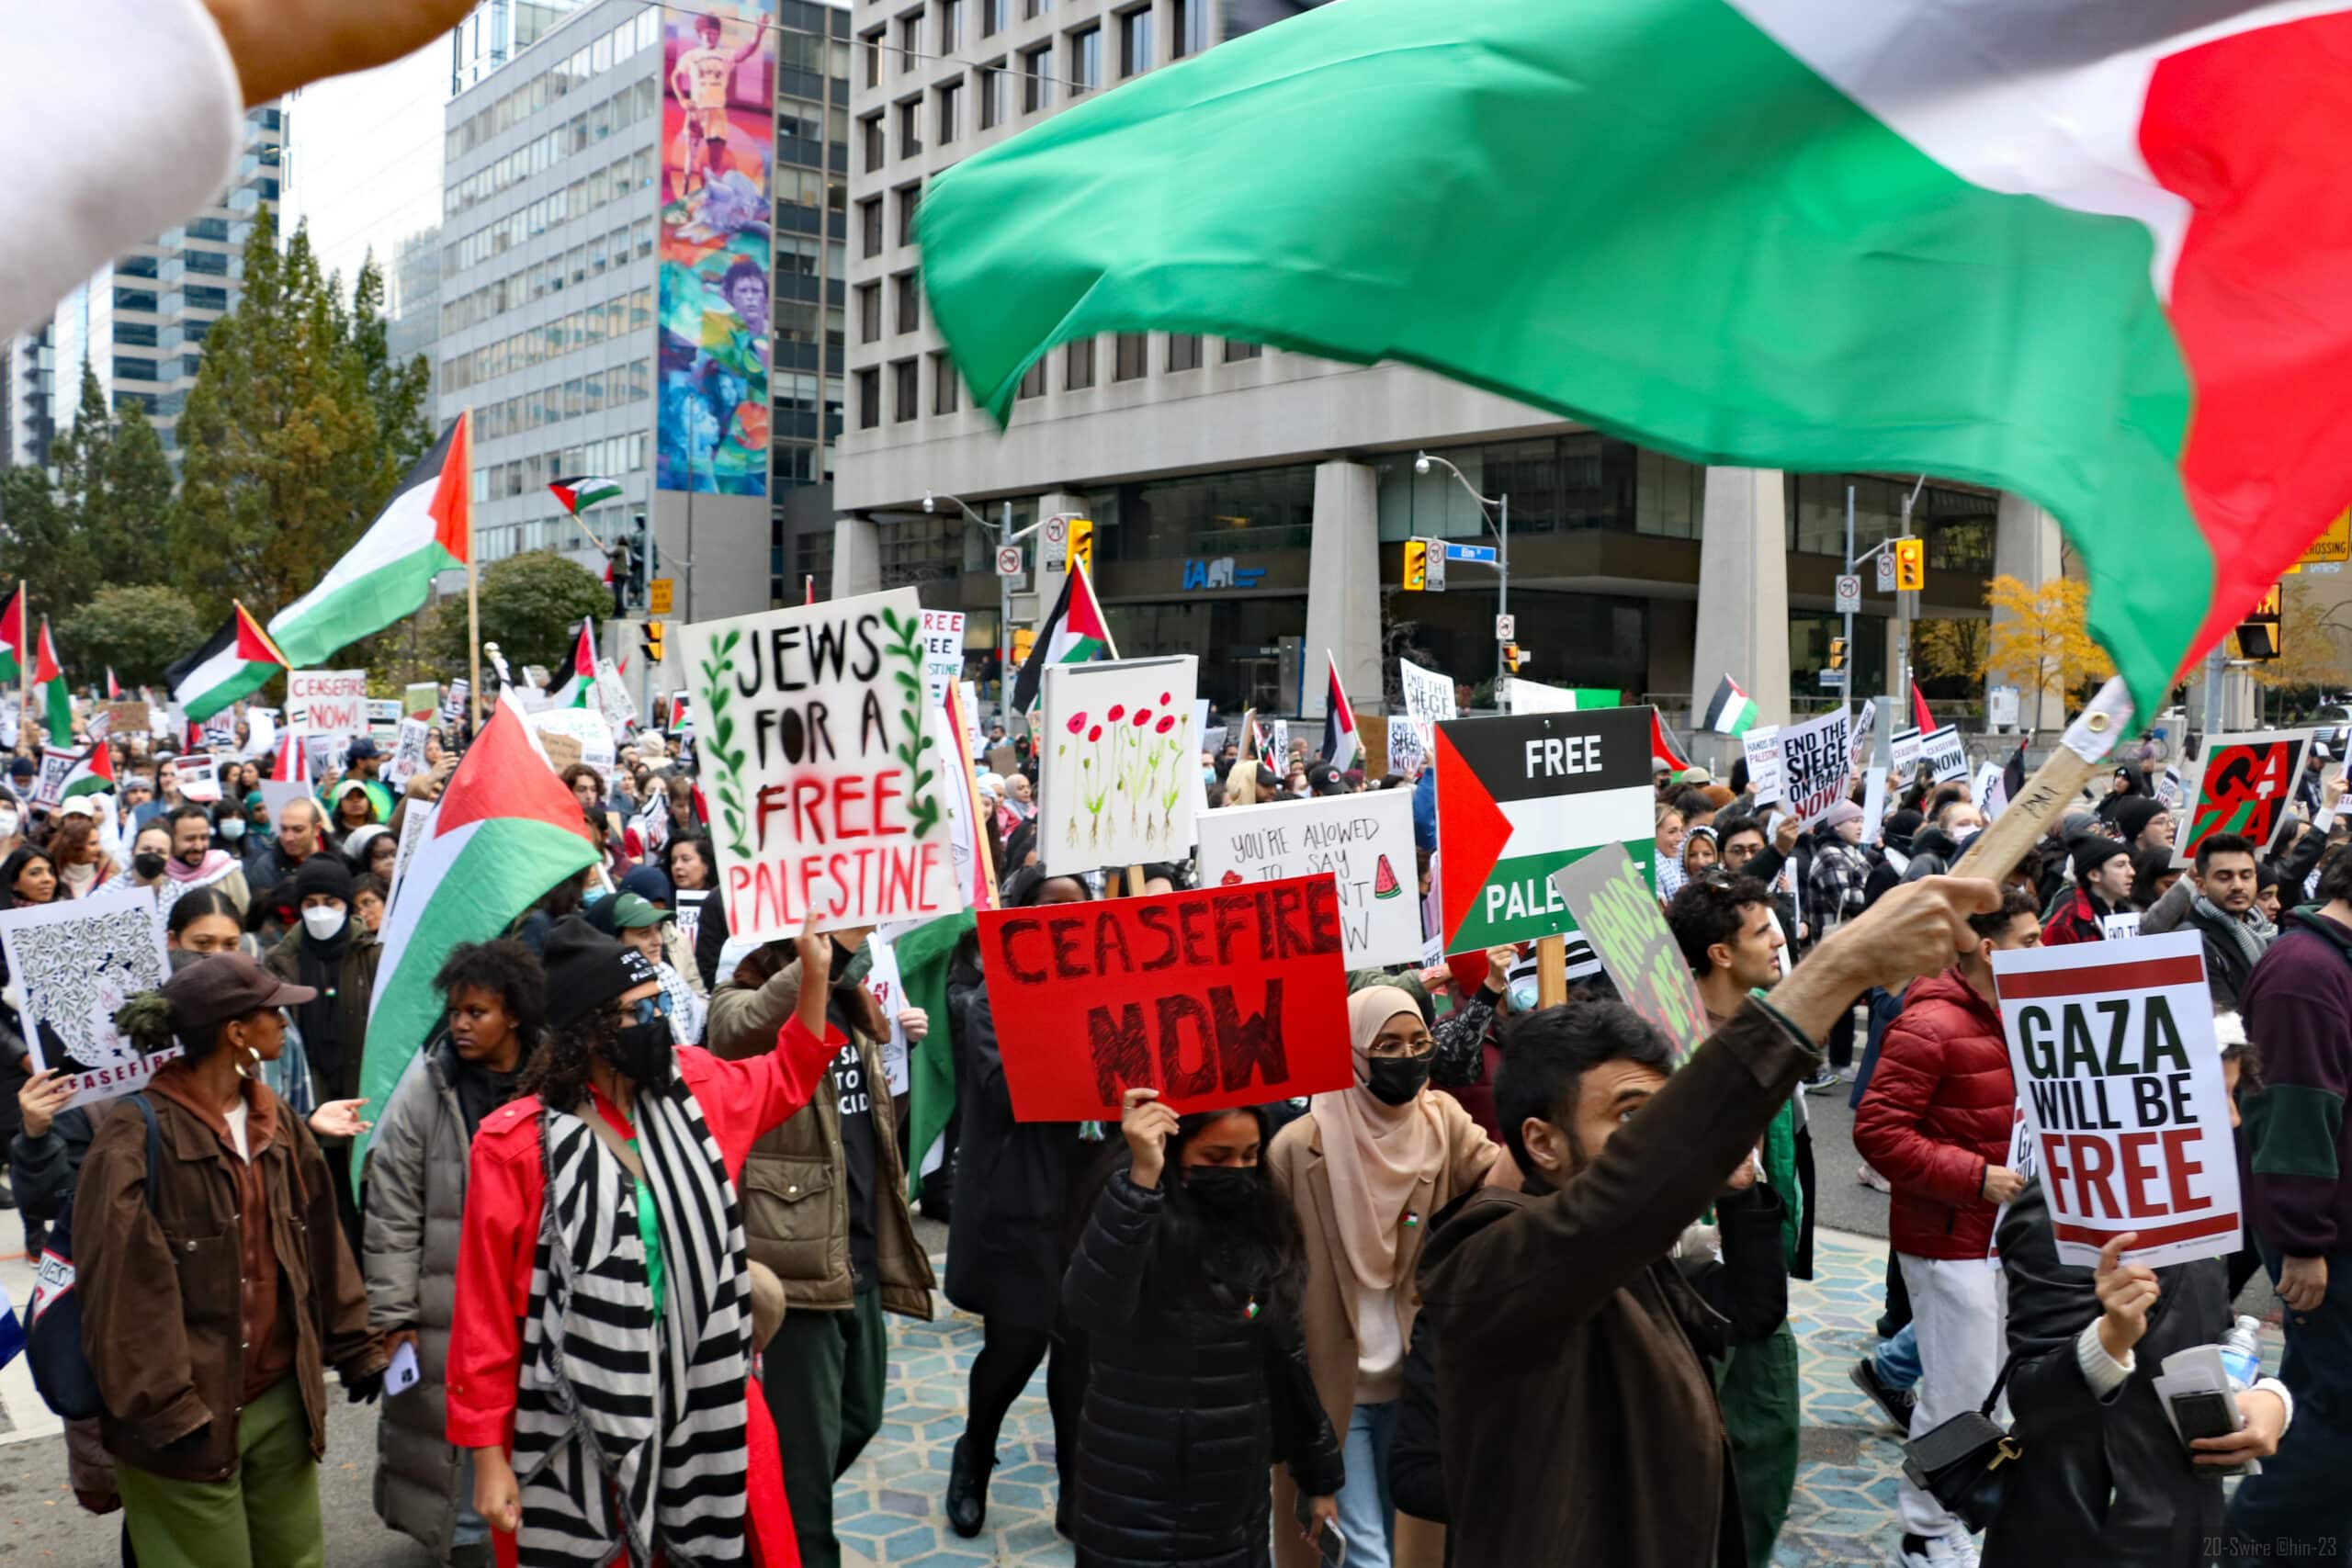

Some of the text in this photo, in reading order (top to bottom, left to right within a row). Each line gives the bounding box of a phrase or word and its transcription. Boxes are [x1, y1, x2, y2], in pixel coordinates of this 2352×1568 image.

[2304, 542, 2346, 556] ROSSING
[920, 613, 963, 632] REE
[738, 615, 880, 698] JEWS
[292, 678, 367, 698] CEASEFIRE
[309, 704, 357, 729] NOW!
[754, 689, 888, 770] FOR A
[1784, 732, 1816, 759] END
[1821, 718, 1847, 744] THE
[1525, 735, 1602, 778] FREE
[1787, 736, 1847, 784] SIEGE
[1932, 749, 1962, 773] NOW
[1790, 779, 1812, 803] ON
[1815, 761, 1849, 791] GAZA
[1794, 777, 1844, 821] NOW!
[757, 771, 906, 852] FREE
[1231, 818, 1379, 863] YOU'RE ALLOWED
[1257, 849, 1351, 880] TO SAY
[729, 843, 940, 935] PALESTINE
[1000, 881, 1342, 984] CEASEFIRE
[1088, 977, 1290, 1108] NOW
[2018, 995, 2191, 1079] GAZA
[52, 1051, 177, 1094] EASEFIR
[2029, 1073, 2198, 1131] WILL BE
[2041, 1128, 2212, 1219] FREE
